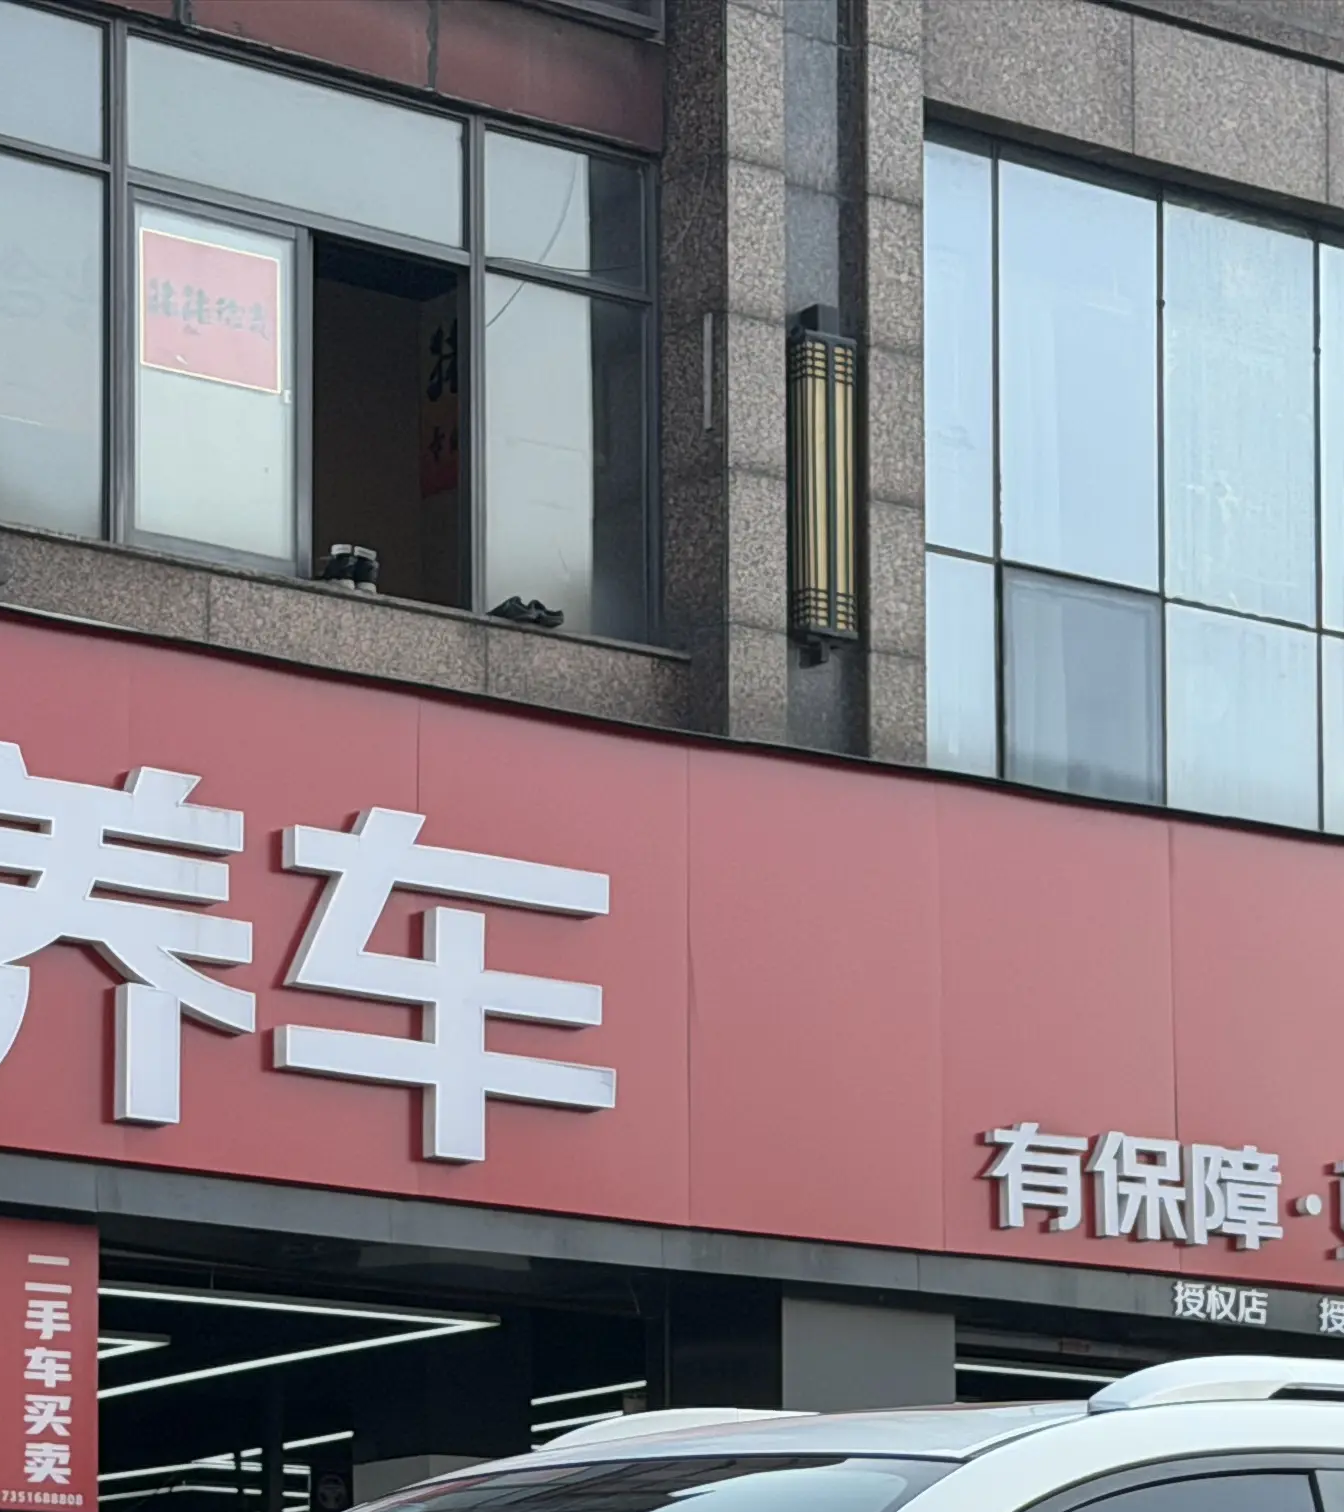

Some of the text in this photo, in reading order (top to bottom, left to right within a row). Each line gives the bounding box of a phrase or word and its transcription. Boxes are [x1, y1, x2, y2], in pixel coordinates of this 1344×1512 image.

[23, 1253, 73, 1486] 二手车买卖
[1173, 1281, 1270, 1325] 授权店
